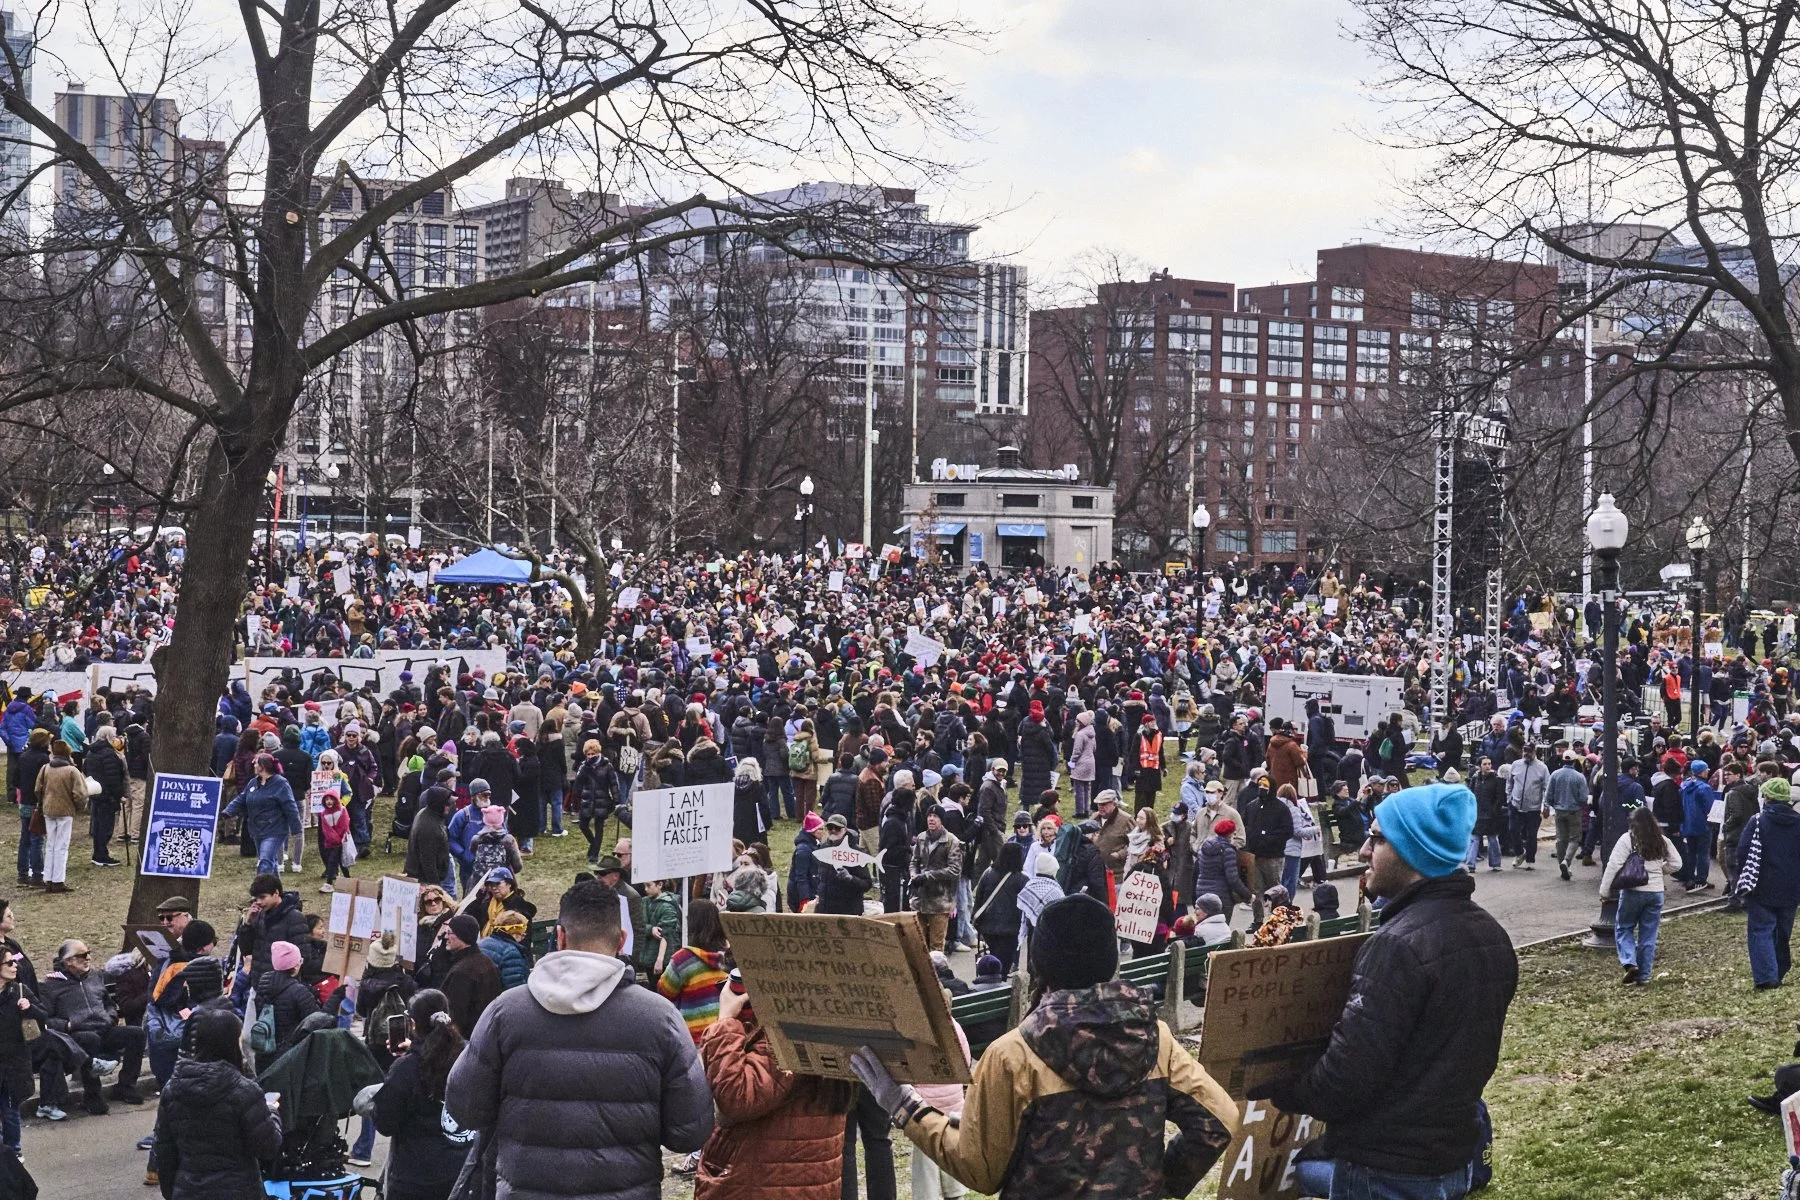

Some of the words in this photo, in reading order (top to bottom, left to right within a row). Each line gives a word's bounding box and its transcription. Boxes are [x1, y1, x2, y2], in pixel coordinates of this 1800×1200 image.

[931, 457, 980, 481] flour
[161, 780, 204, 792] DONATE
[160, 791, 188, 802] HERE
[668, 792, 676, 809] I
[680, 789, 704, 809] AM
[666, 809, 704, 829] ANTI-
[663, 825, 710, 846] FASCIST
[832, 849, 860, 863] RESIST
[1132, 873, 1160, 895] Stop
[1115, 903, 1158, 918] judicial
[727, 920, 745, 933] NO
[751, 917, 831, 936] TAXPAYER
[837, 919, 851, 936] $
[1115, 919, 1153, 943] killing
[773, 937, 846, 955] BOMBS
[742, 958, 858, 977] CONCENTRATION
[1230, 955, 1290, 980] STOP
[756, 979, 833, 996] KIDNAPPER
[1224, 977, 1305, 1004] PEOPLE
[773, 997, 819, 1015] DATA
[824, 998, 898, 1019] CENTERS
